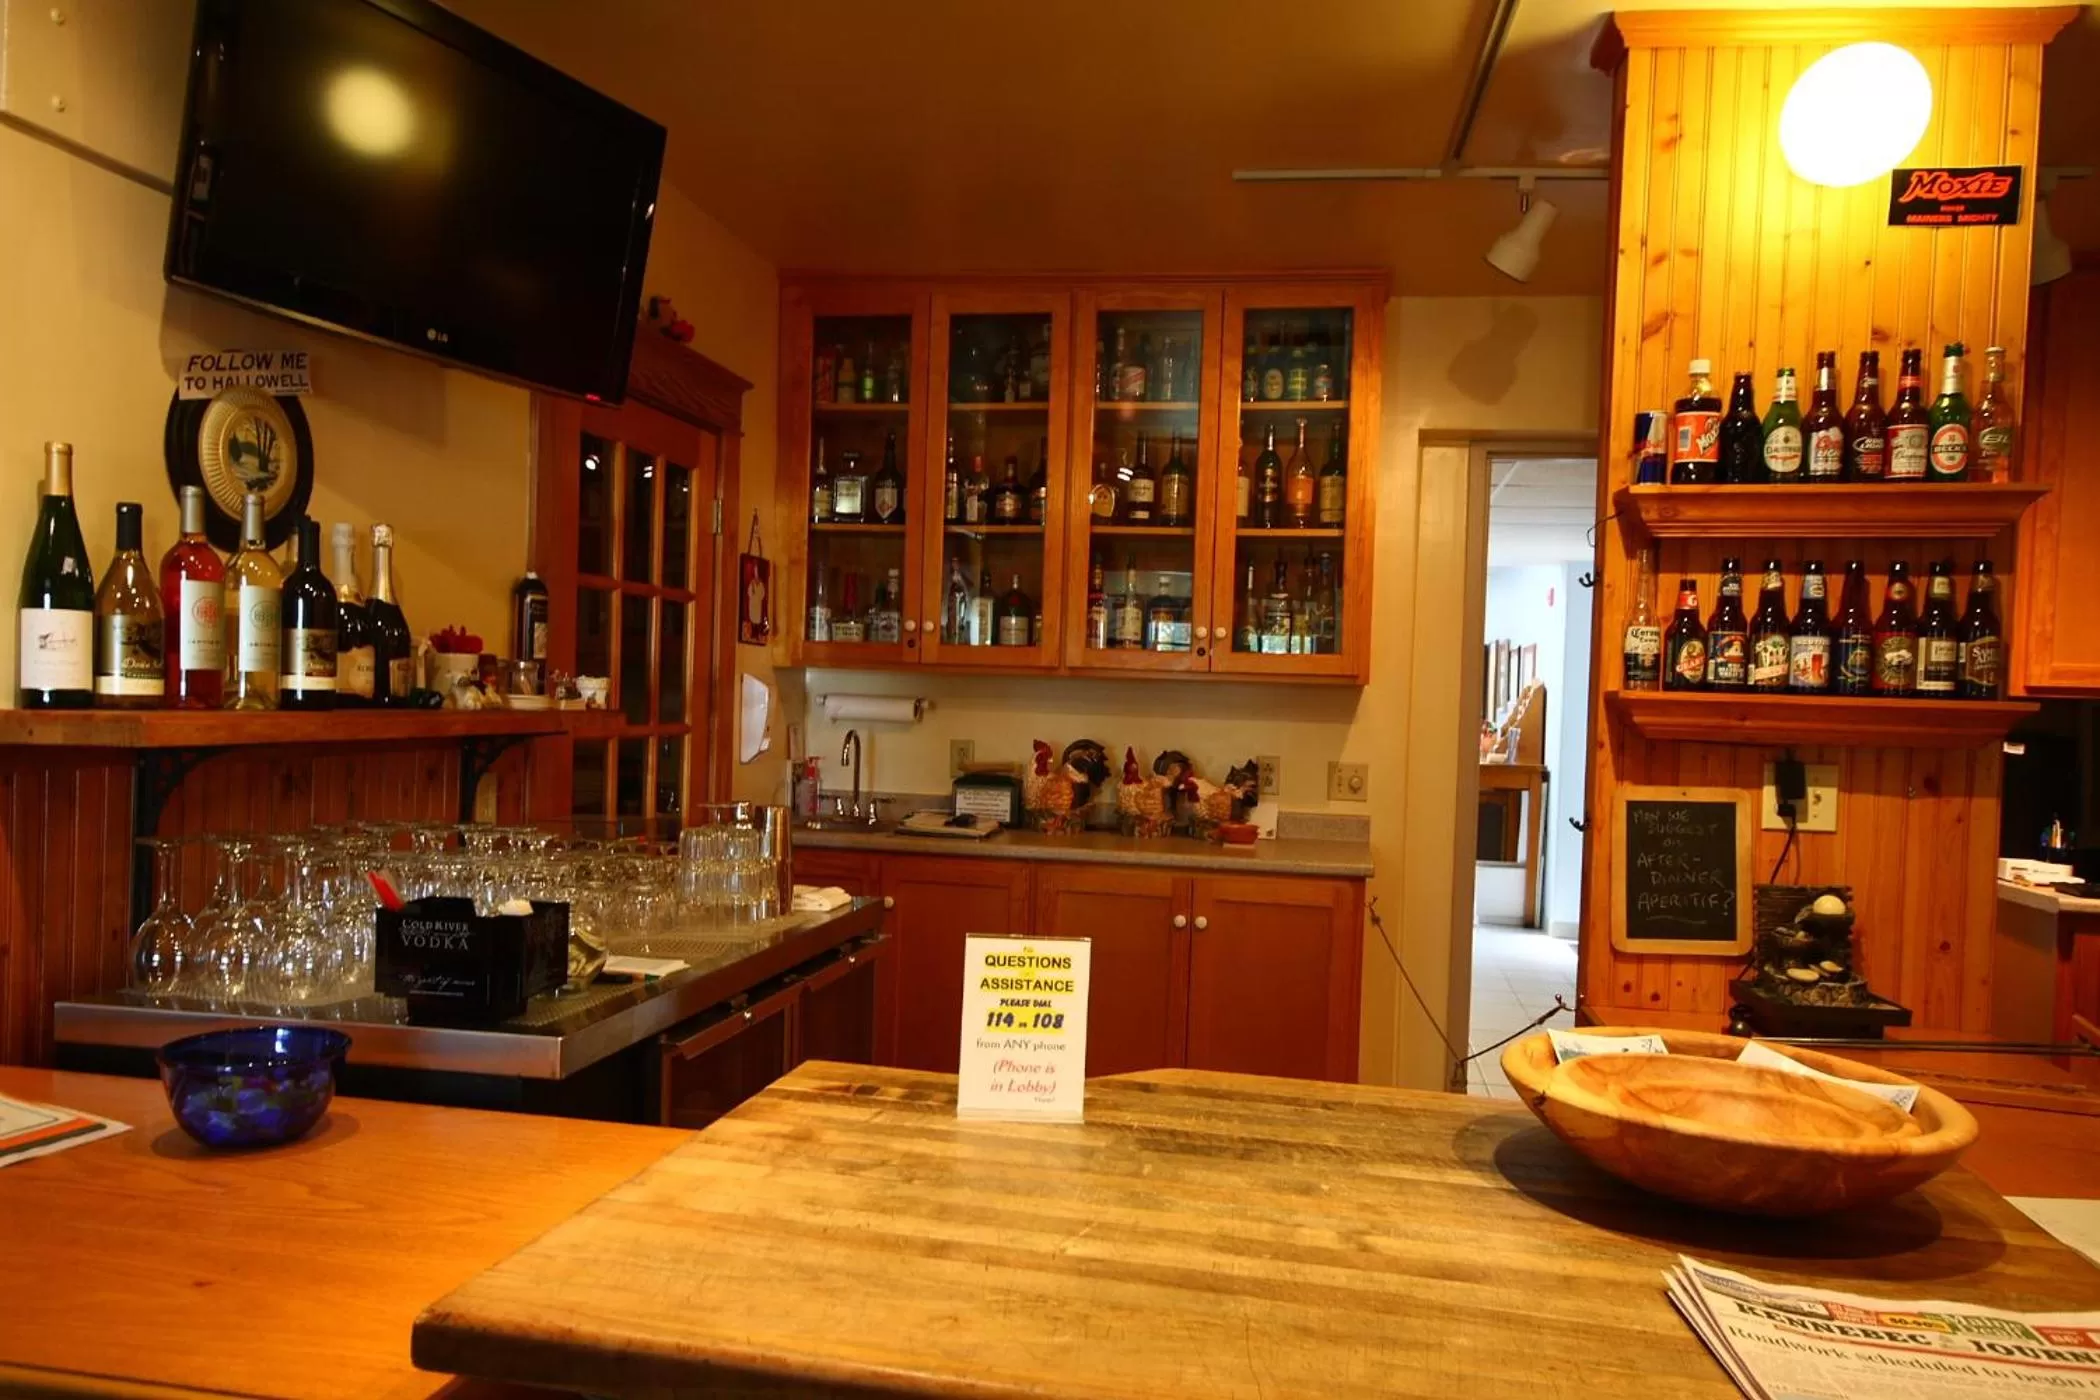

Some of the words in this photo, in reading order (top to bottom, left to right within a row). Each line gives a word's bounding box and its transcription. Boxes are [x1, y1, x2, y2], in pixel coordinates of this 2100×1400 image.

[1899, 171, 2012, 203] MOXIE
[187, 353, 273, 373] FOLLOW
[281, 352, 308, 370] ME
[184, 376, 206, 390] TO
[1667, 808, 1690, 822] WE
[1651, 868, 1726, 888] DINNER
[402, 934, 469, 950] VODKA
[985, 954, 1072, 970] QUESTIONS
[980, 977, 1074, 993] ASSISTANCE
[999, 998, 1031, 1007] PLEASE
[1033, 999, 1052, 1008] DIAL
[987, 1011, 1014, 1028] 114
[1033, 1013, 1065, 1029] 108
[976, 1037, 1001, 1048] from
[1004, 1038, 1031, 1050] ANY
[1033, 1041, 1066, 1052] phone
[993, 1059, 1042, 1074] (Phone
[1045, 1061, 1056, 1074] is
[990, 1082, 1003, 1092] in
[1007, 1079, 1057, 1096] Lobby)
[1735, 1302, 1932, 1346] KENNEBEC
[1967, 1339, 2100, 1366] JOURN
[1728, 1324, 1850, 1361] Roadwork
[1854, 1348, 1980, 1376] scheduled
[1982, 1367, 2010, 1379] to
[2012, 1369, 2086, 1389] begin
